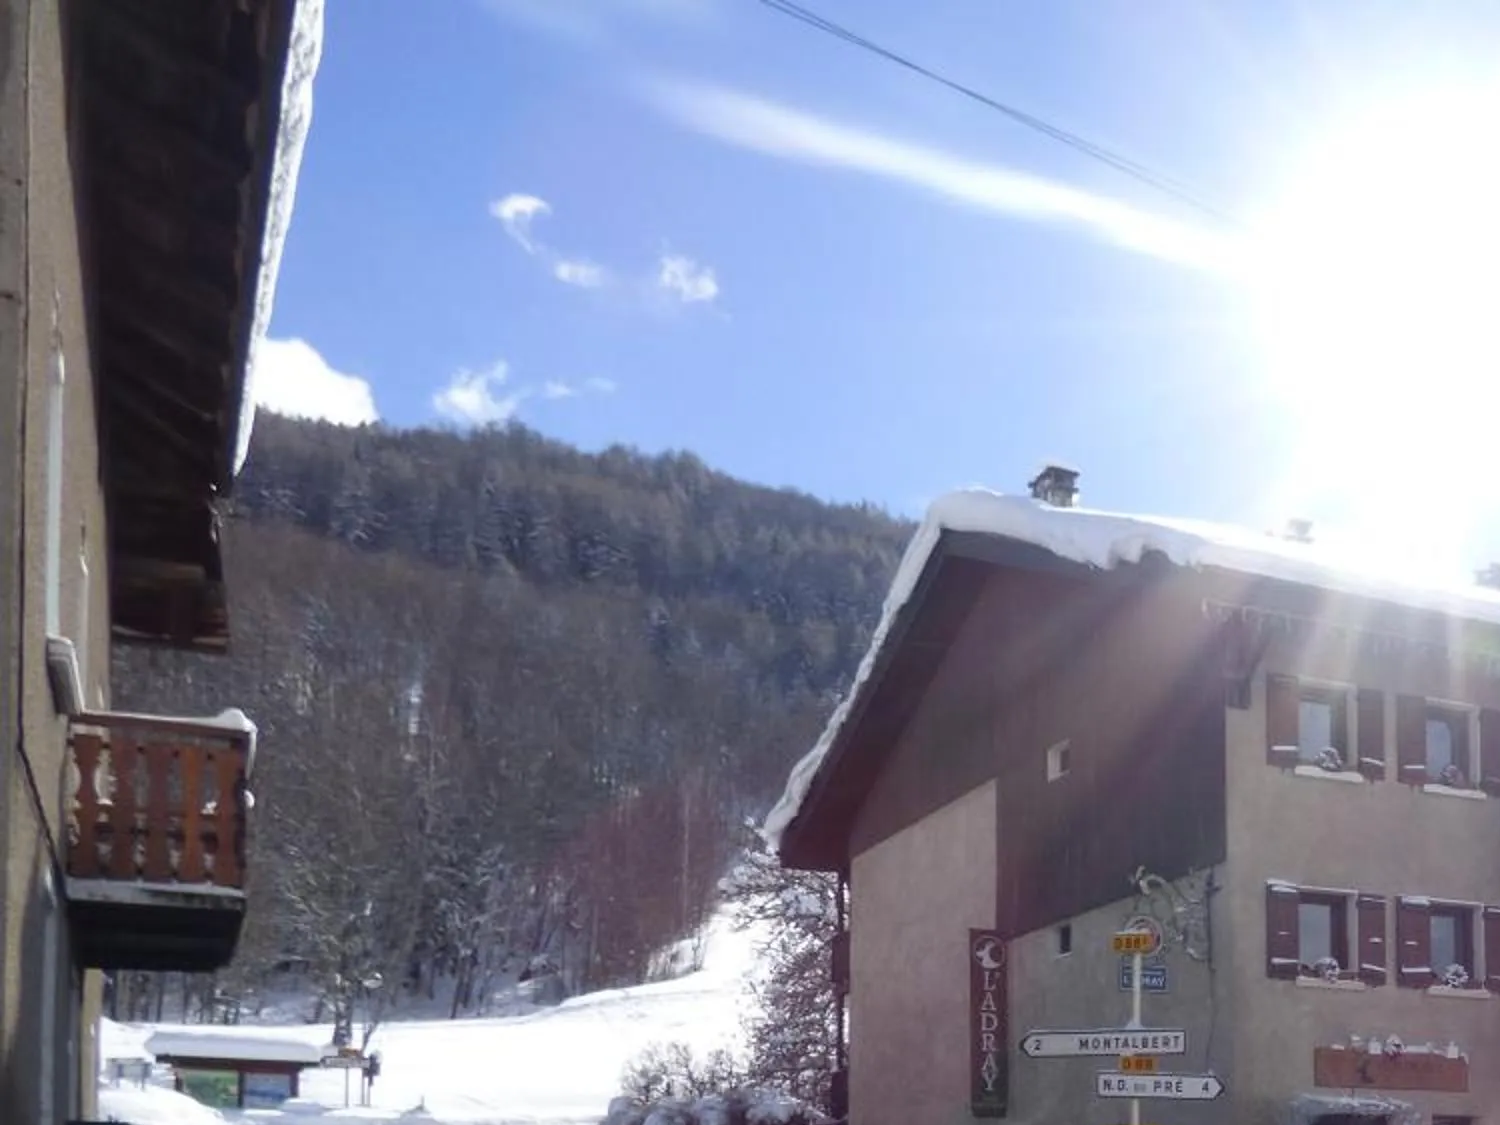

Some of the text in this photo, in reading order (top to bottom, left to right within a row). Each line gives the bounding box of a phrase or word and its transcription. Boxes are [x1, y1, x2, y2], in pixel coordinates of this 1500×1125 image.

[1033, 1035, 1181, 1051] 2 MONTALBERT
[1201, 1080, 1210, 1092] 4
